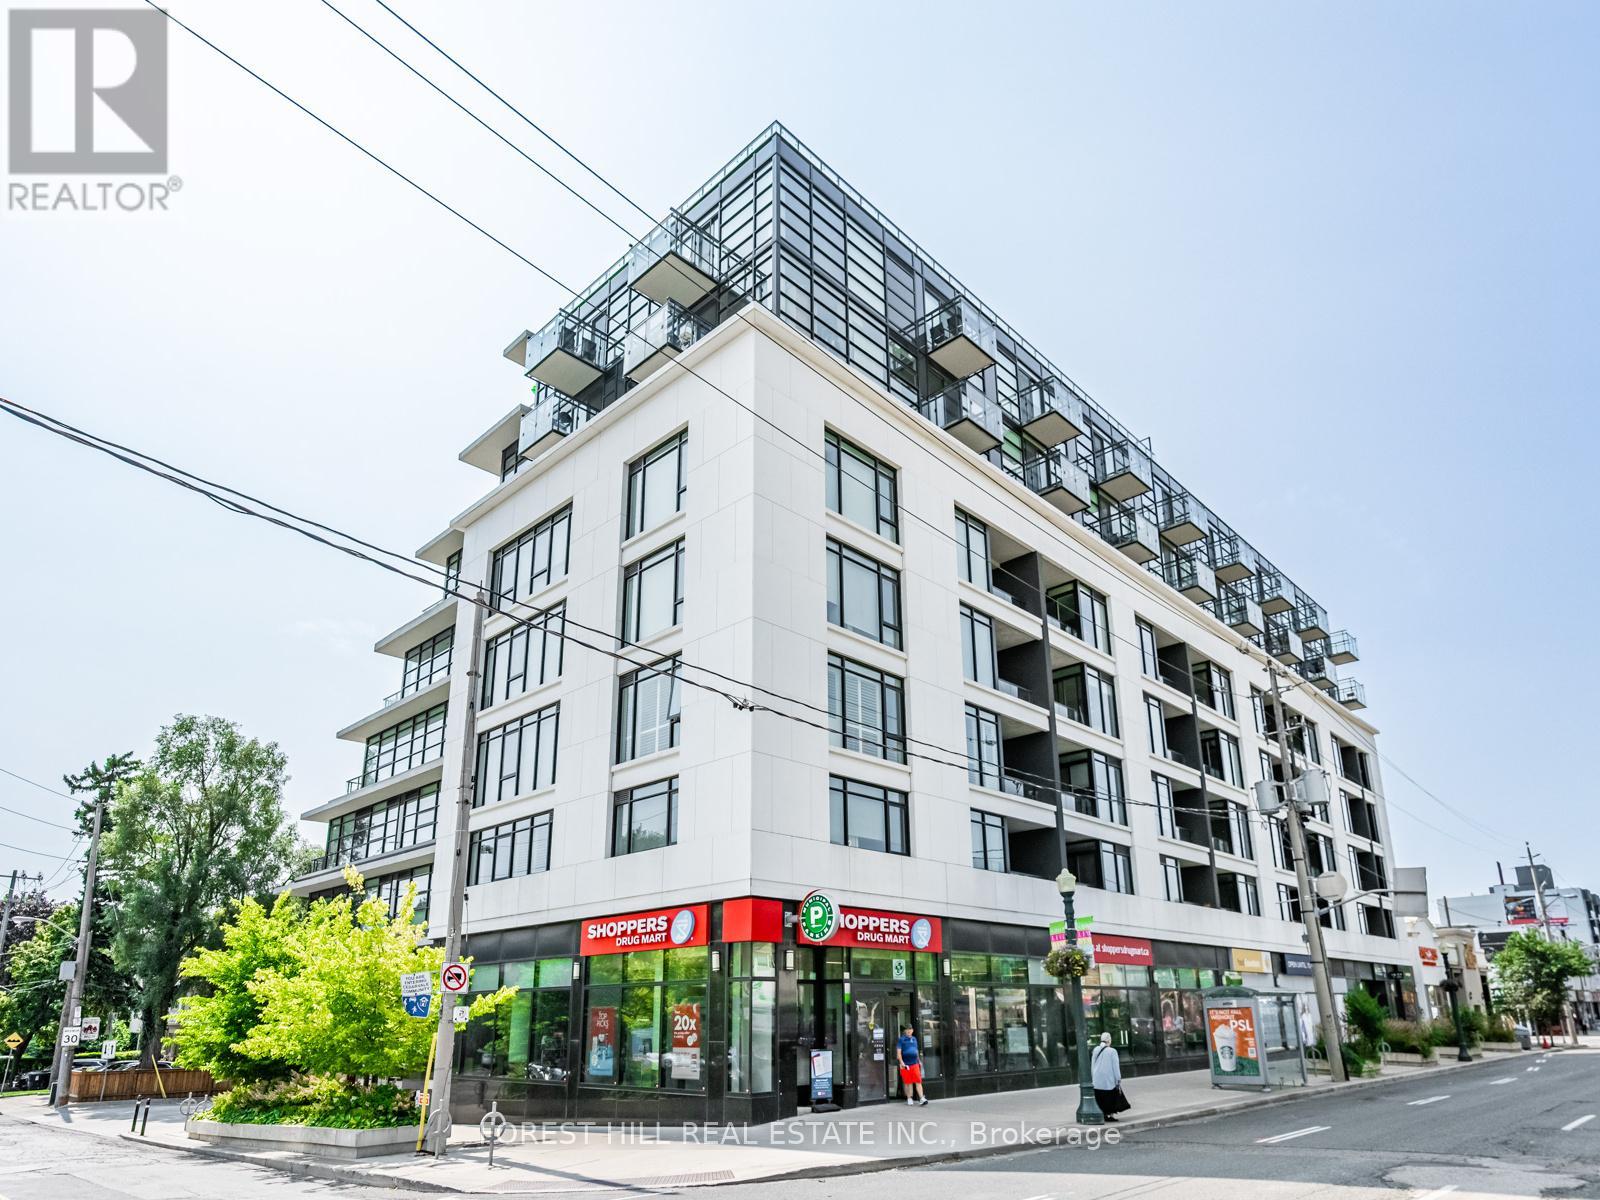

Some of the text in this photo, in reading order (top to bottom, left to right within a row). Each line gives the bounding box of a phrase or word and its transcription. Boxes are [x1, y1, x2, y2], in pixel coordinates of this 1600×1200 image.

[802, 896, 831, 914] MUNICIPAL
[810, 906, 823, 926] P
[839, 913, 910, 934] HOPPERS
[587, 915, 668, 939] SHOPPERS
[802, 920, 832, 939] PARKING
[615, 933, 667, 947] DRUG MART
[857, 932, 910, 945] DRUG MART
[673, 1015, 697, 1031] 20x
[1230, 1019, 1253, 1032] PSL
[63, 1034, 78, 1044] 30
